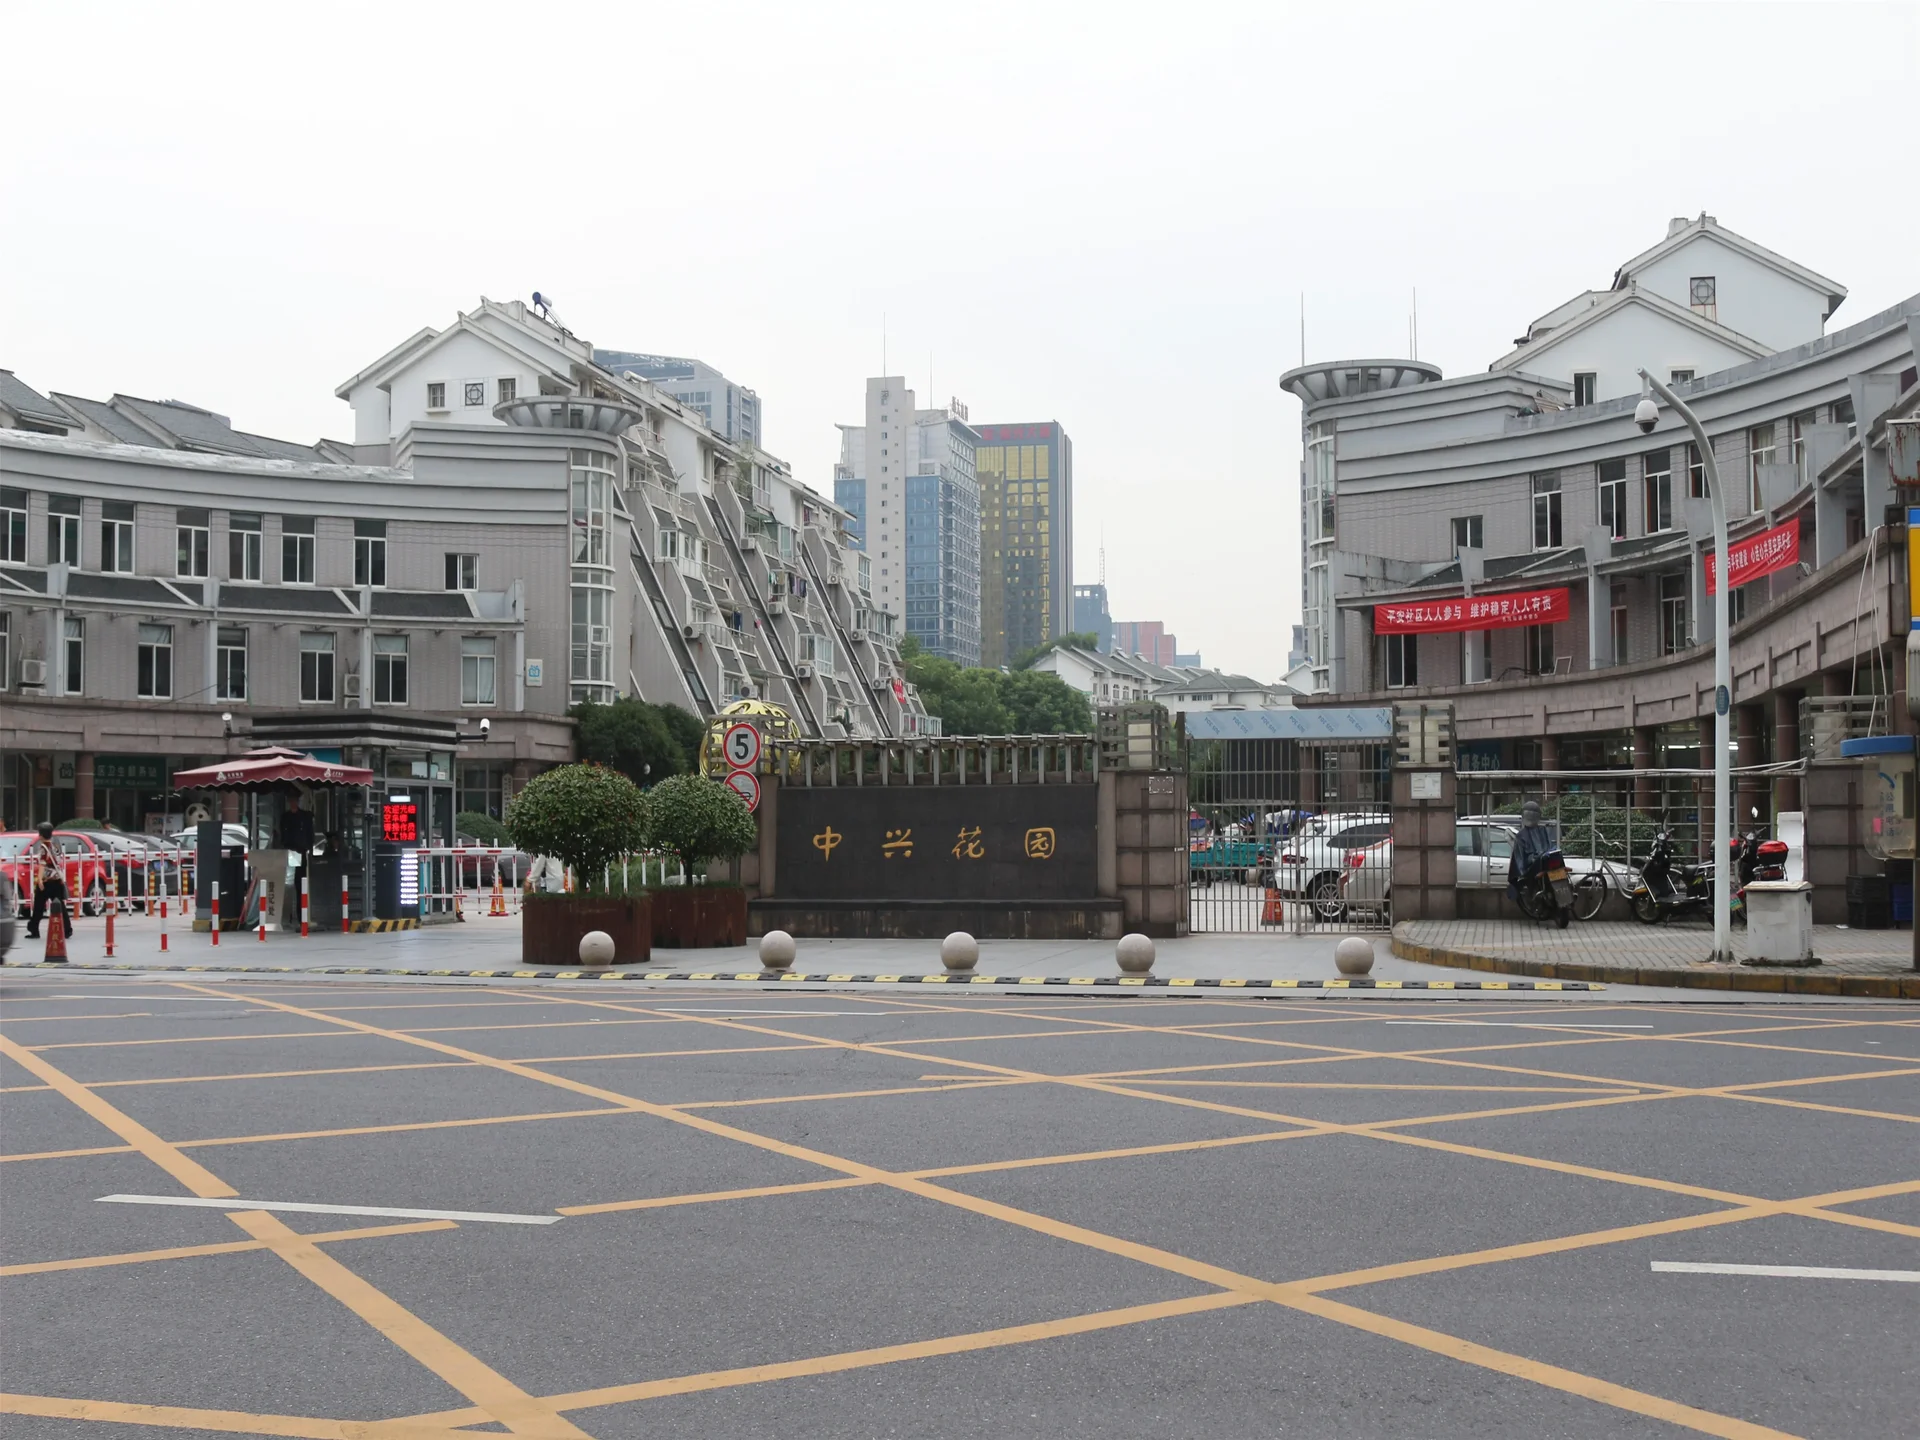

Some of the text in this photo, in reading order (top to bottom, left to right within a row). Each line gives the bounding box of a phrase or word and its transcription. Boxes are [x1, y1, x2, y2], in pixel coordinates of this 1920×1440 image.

[1386, 605, 1462, 624] 平安社区人人参与
[1470, 596, 1552, 618] 维护稳定人人有责
[734, 734, 749, 760] 5
[1458, 753, 1500, 771] 服务中心
[384, 805, 416, 814] 欢迎光临
[812, 826, 1056, 862] 中兴花园
